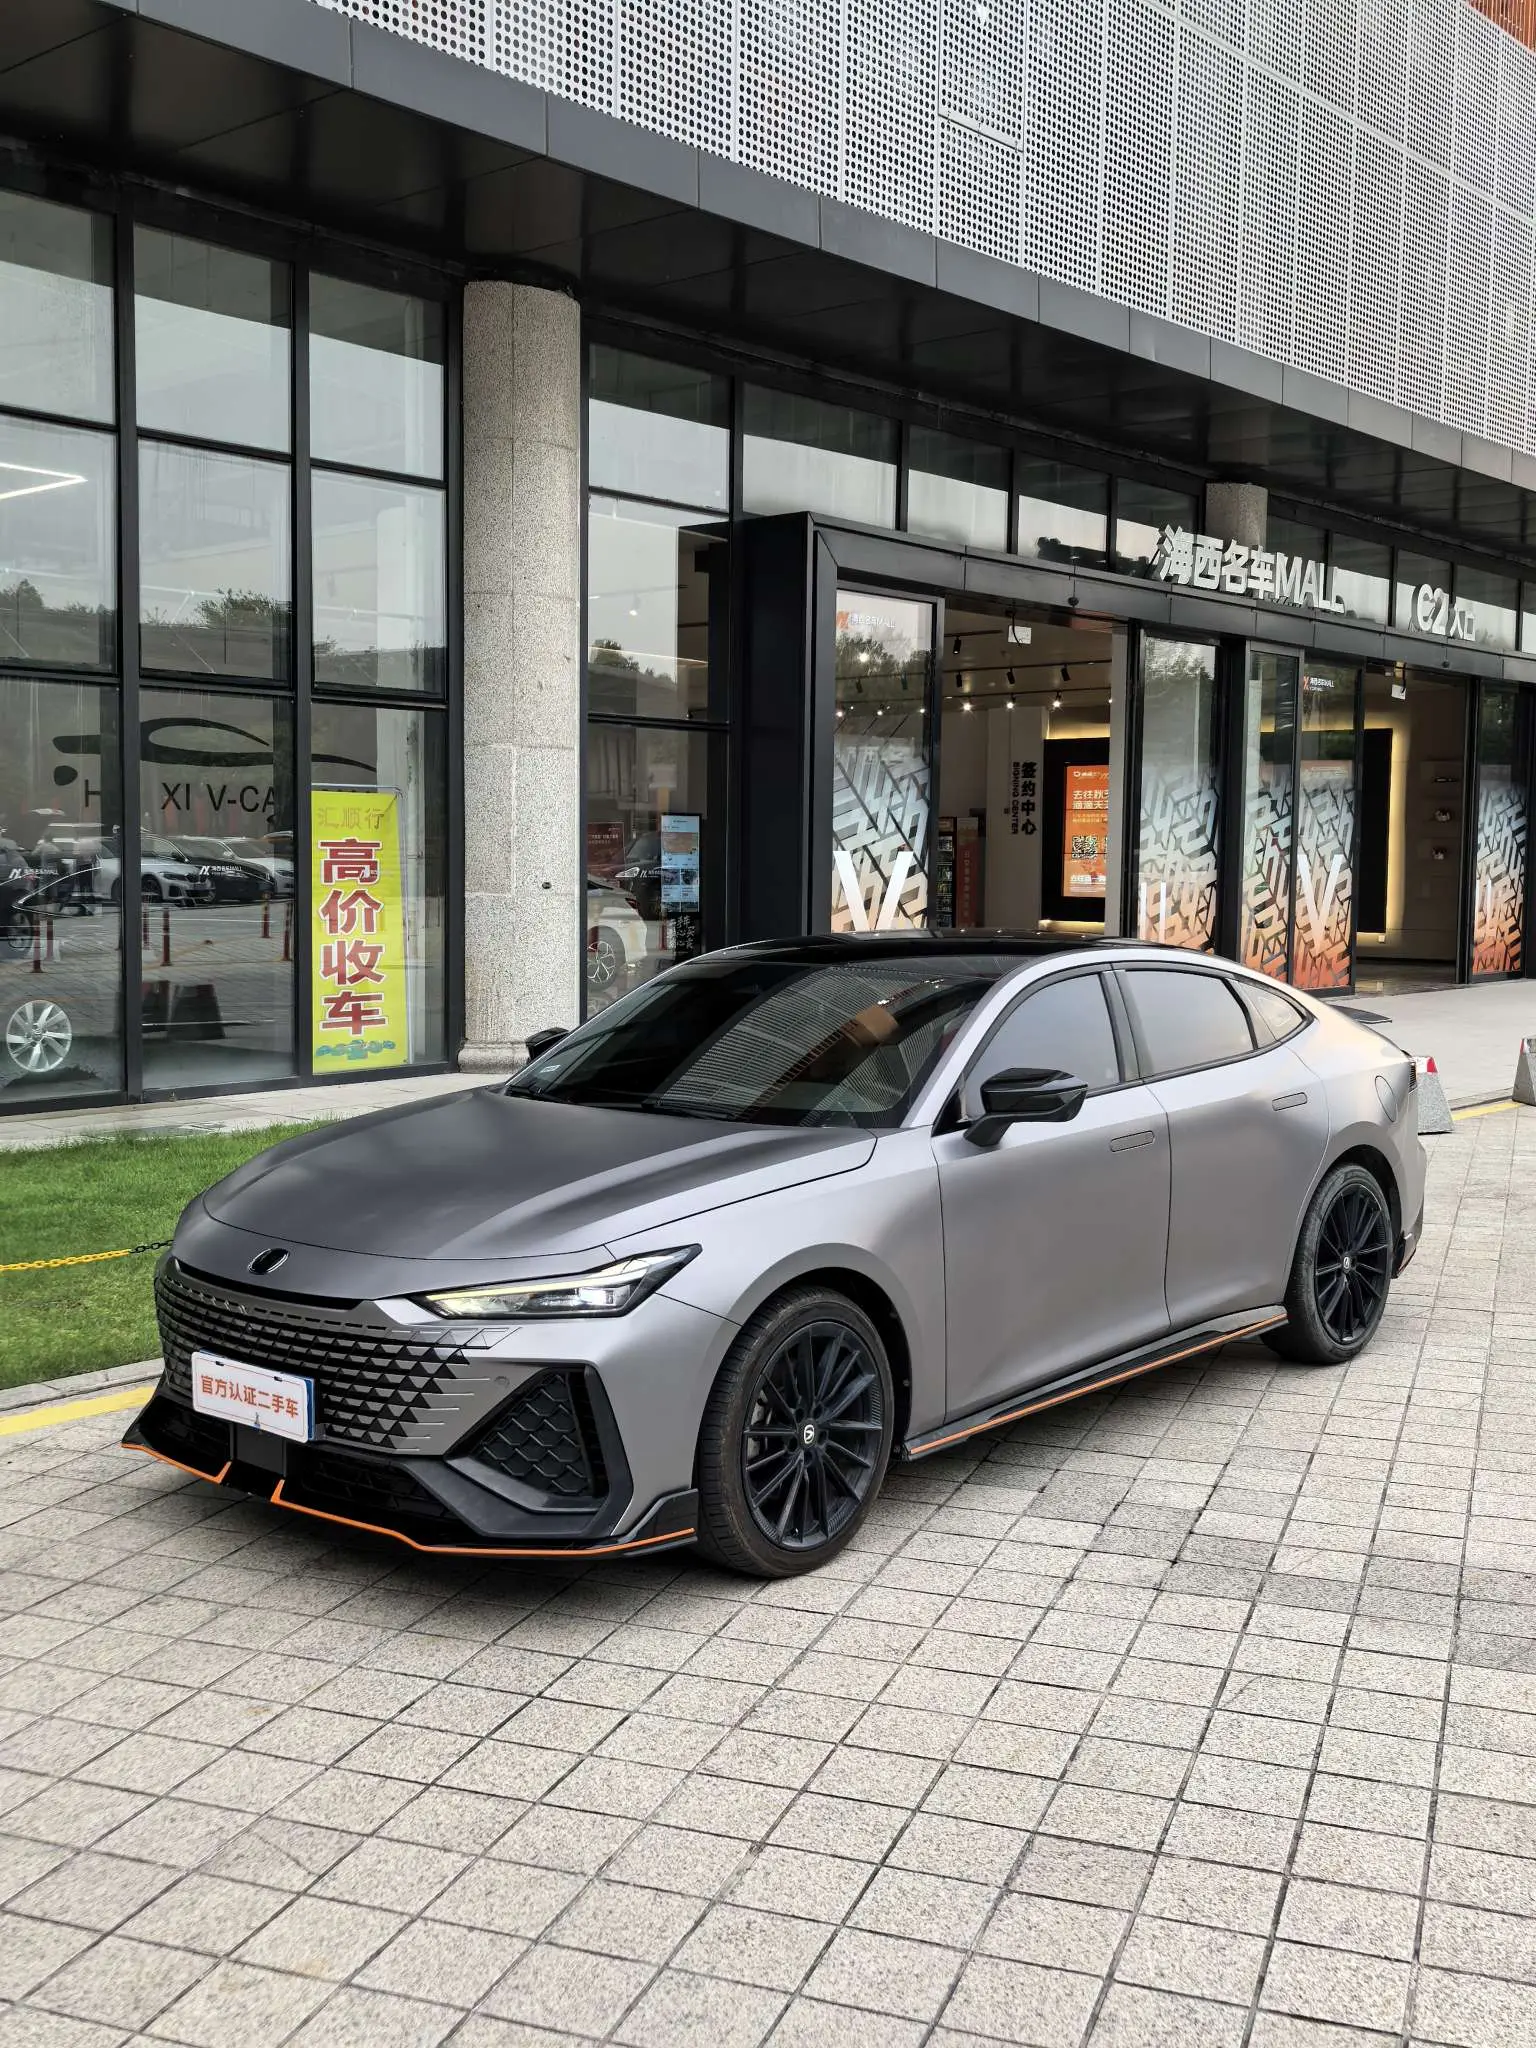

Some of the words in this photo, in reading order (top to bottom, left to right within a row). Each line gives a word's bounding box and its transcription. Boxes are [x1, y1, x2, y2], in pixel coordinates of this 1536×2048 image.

[1159, 524, 1345, 613] 海西名车MALL
[319, 837, 388, 1036] 高价收车
[200, 1374, 299, 1419] 官方认证二手车
